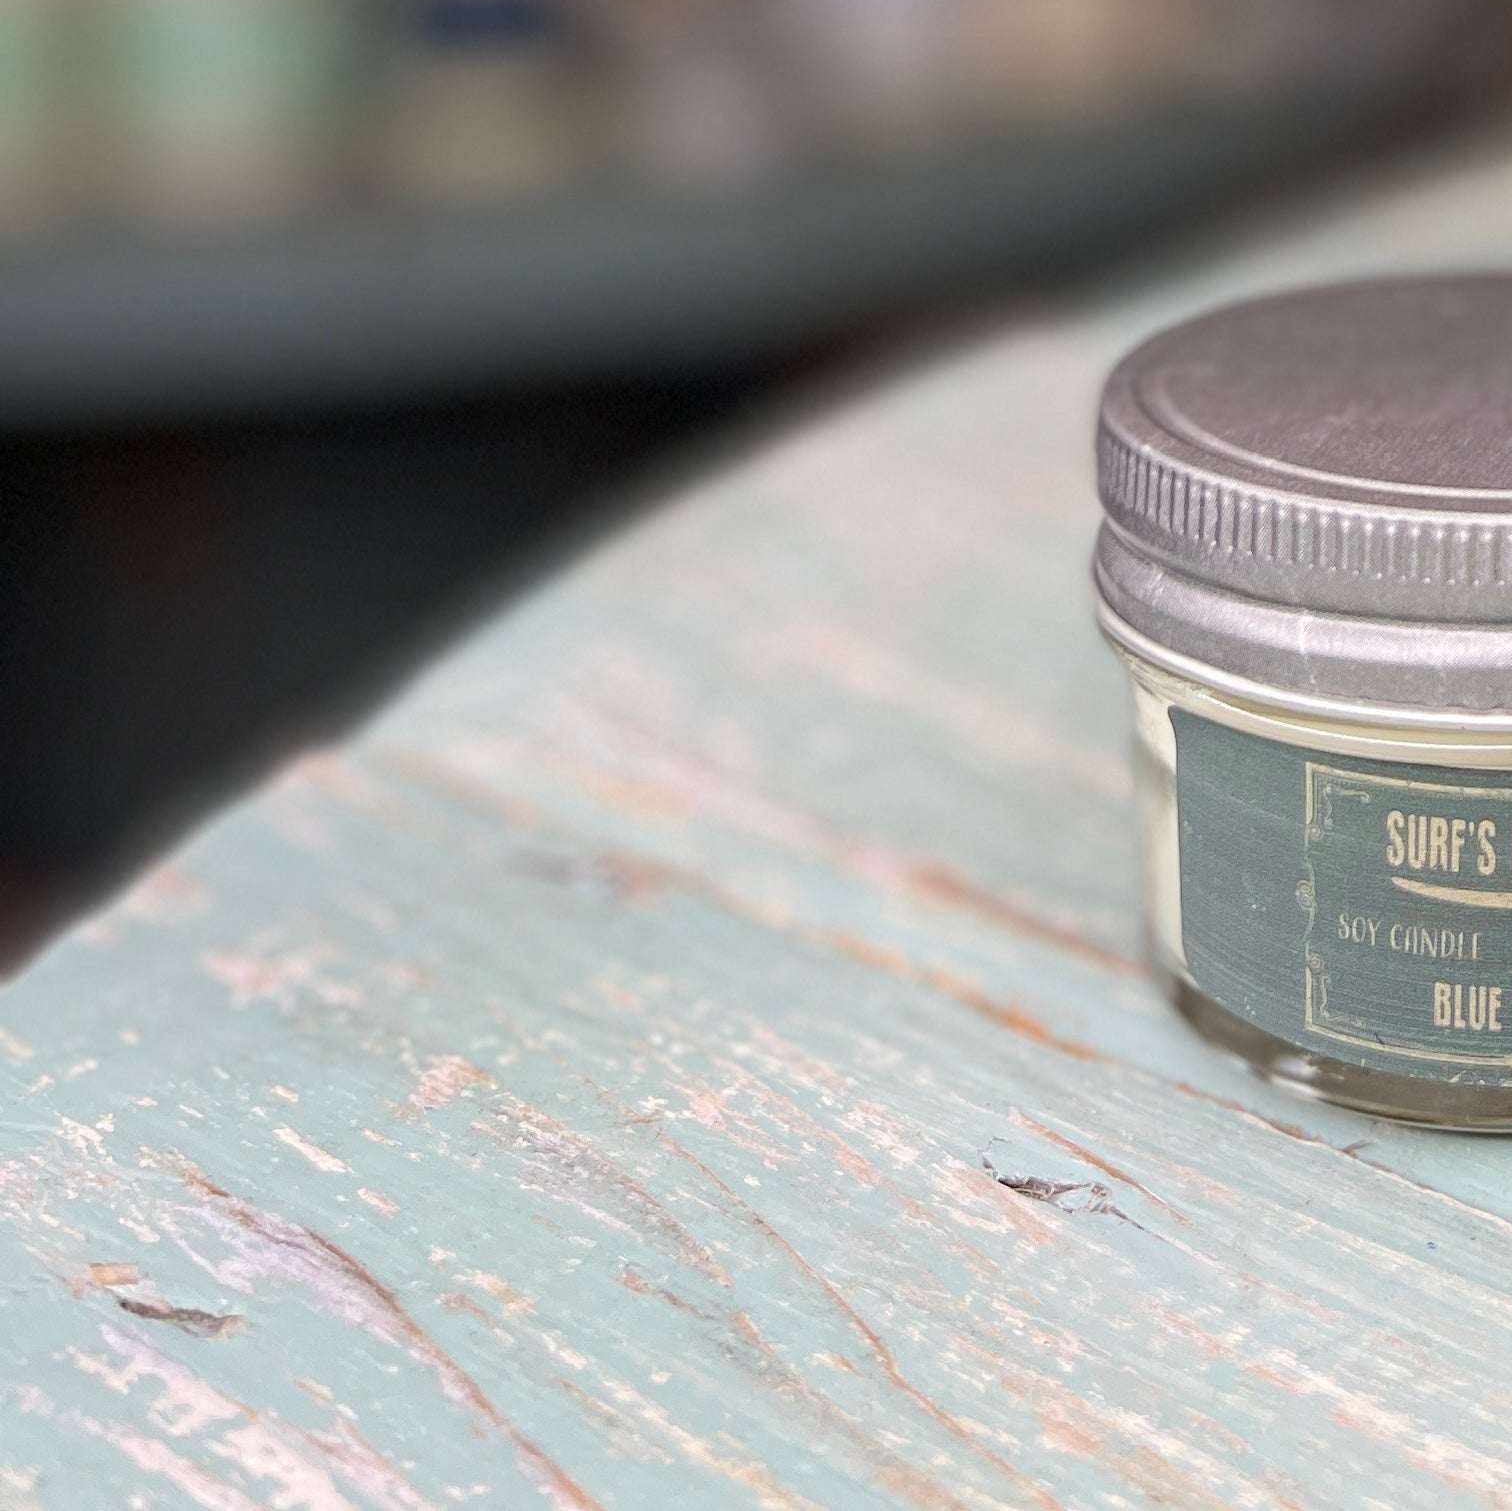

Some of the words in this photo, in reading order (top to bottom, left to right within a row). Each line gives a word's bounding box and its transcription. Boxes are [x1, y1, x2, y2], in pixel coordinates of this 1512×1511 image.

[1386, 810, 1496, 876] SURF'S
[1338, 911, 1382, 947] SOY
[1389, 923, 1482, 960] CANDLE
[1433, 980, 1502, 1031] BLUE
